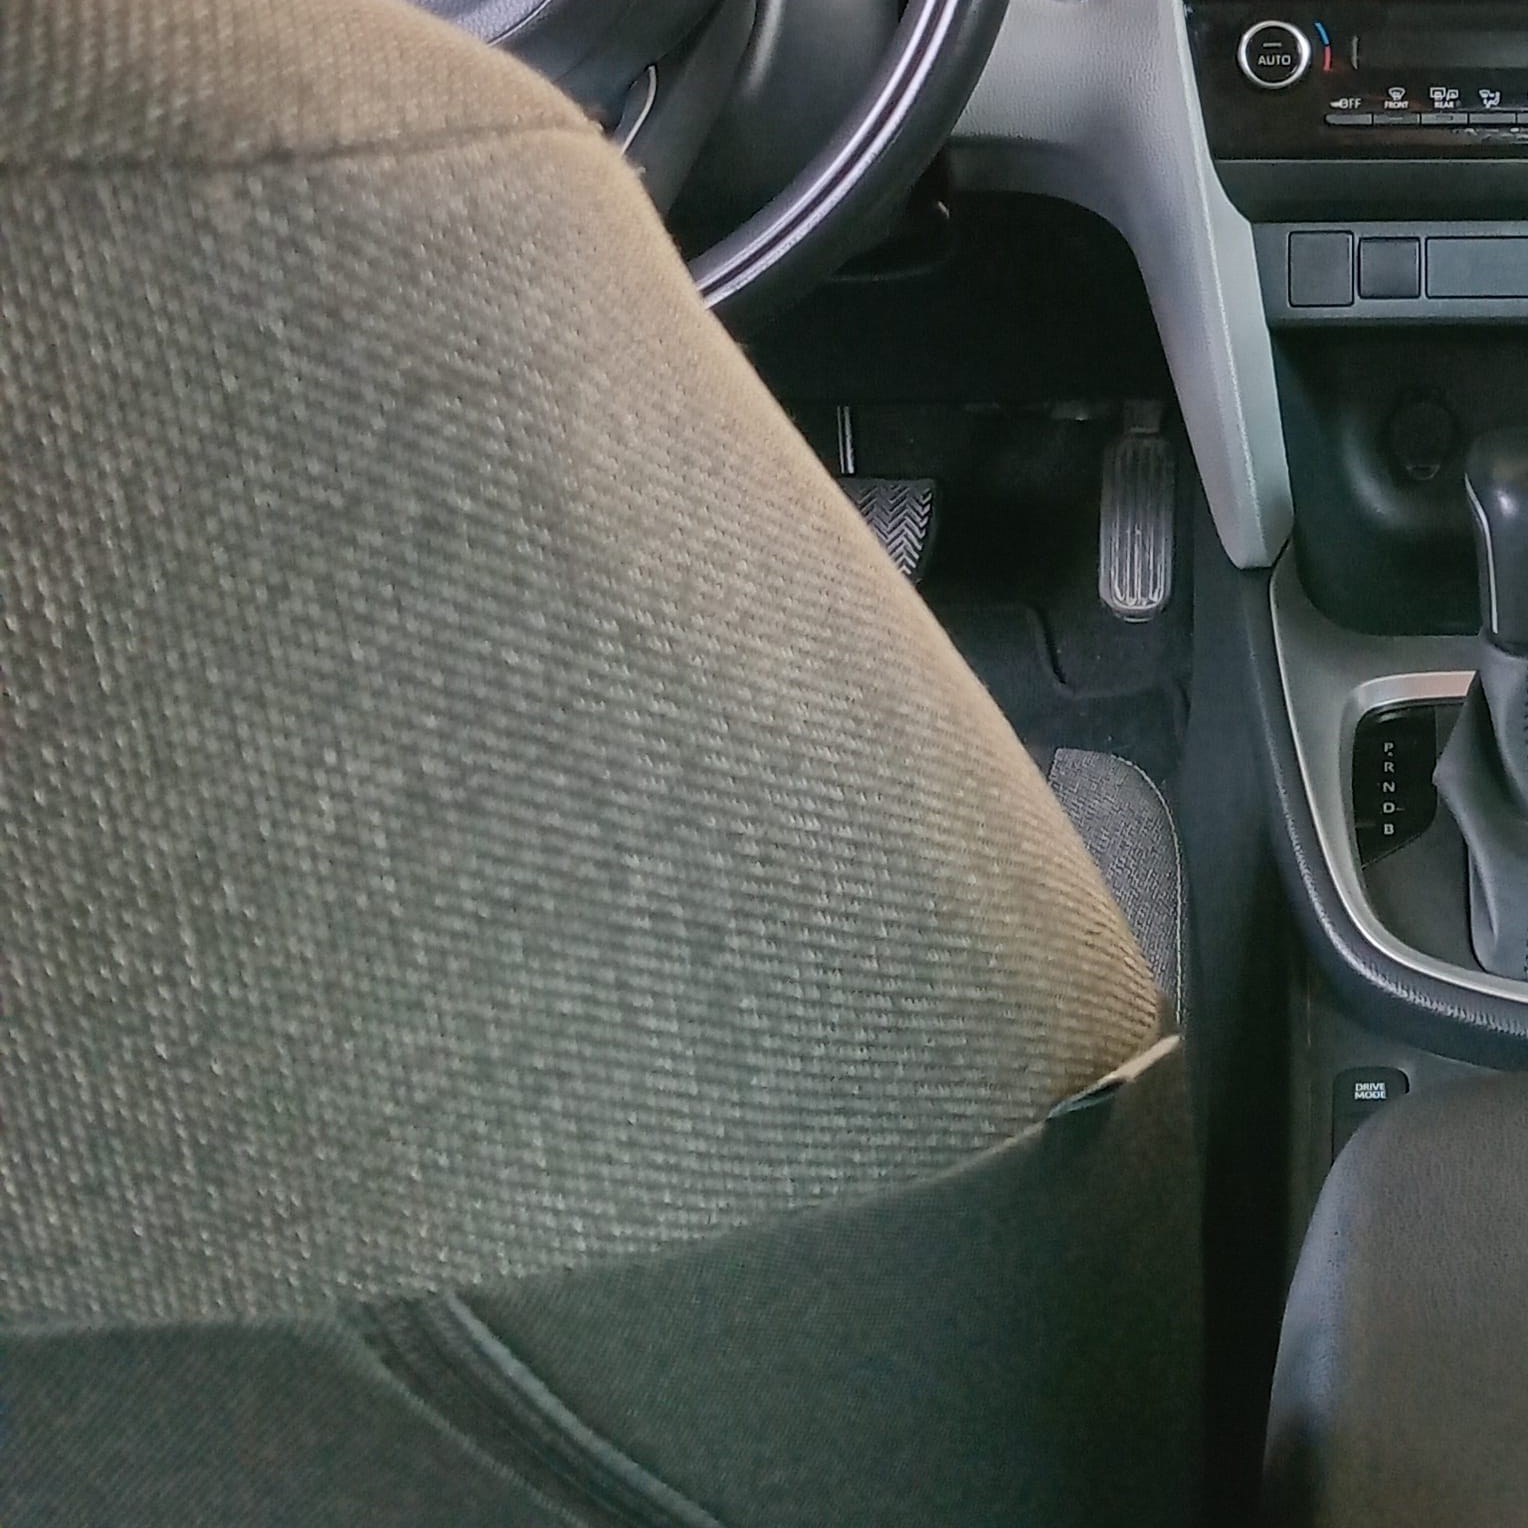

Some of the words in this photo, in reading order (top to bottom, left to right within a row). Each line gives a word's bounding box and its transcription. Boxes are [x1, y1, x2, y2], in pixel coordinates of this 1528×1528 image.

[1257, 54, 1291, 66] AUTO
[1339, 98, 1362, 109] OFF
[1384, 101, 1409, 109] FRONT
[1434, 101, 1455, 109] REAR
[1383, 742, 1394, 752] P
[1383, 761, 1394, 773] R
[1382, 781, 1395, 793] N
[1382, 802, 1395, 813] D
[1383, 823, 1394, 835] B
[1355, 1082, 1385, 1091] DRIVE
[1354, 1091, 1387, 1100] MODE
